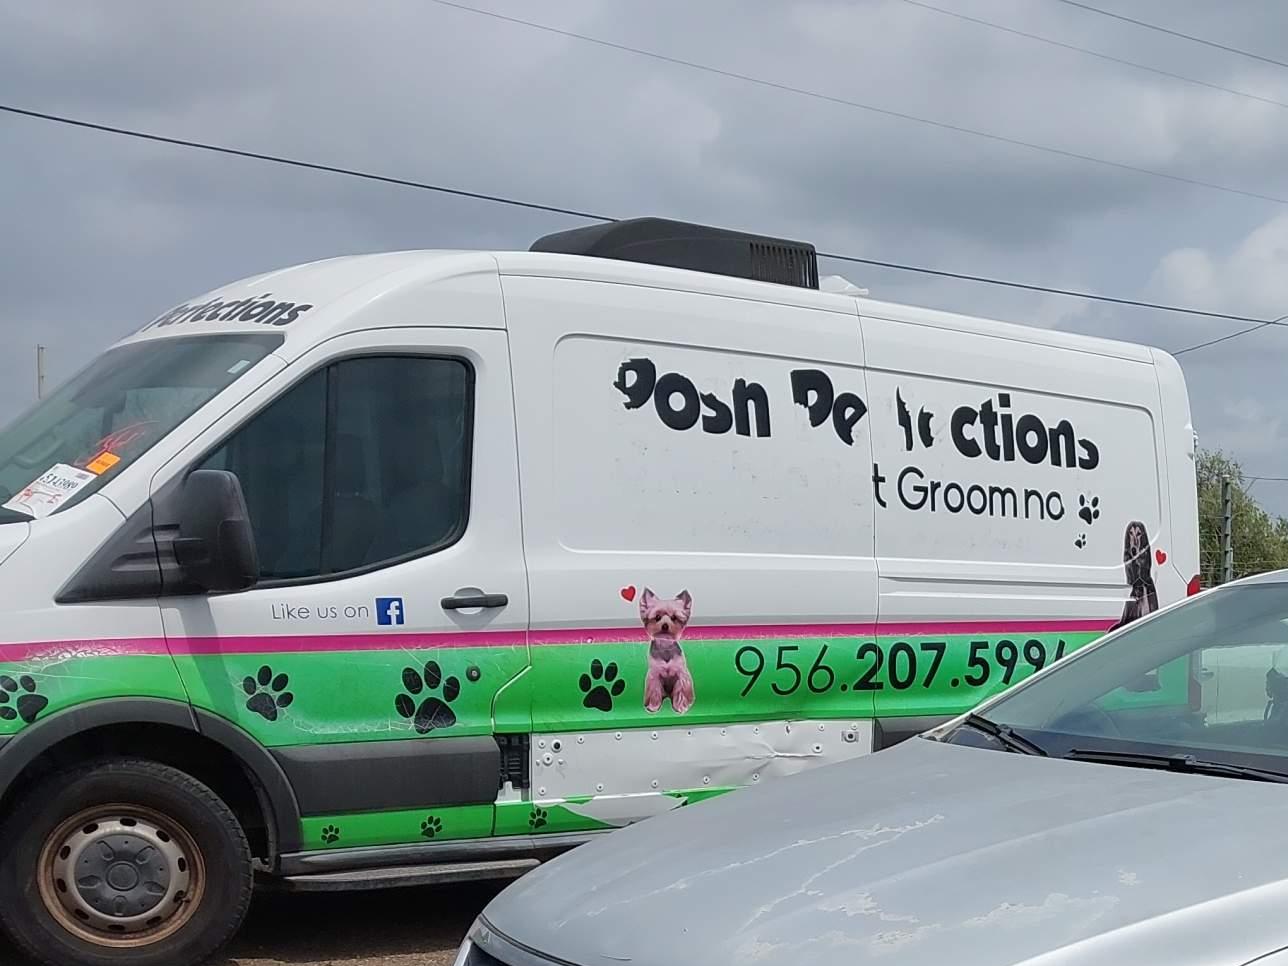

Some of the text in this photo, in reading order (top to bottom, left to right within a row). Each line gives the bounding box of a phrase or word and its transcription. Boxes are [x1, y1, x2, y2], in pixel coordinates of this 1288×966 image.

[271, 603, 310, 619] Like
[317, 606, 337, 618] us
[344, 606, 368, 618] on
